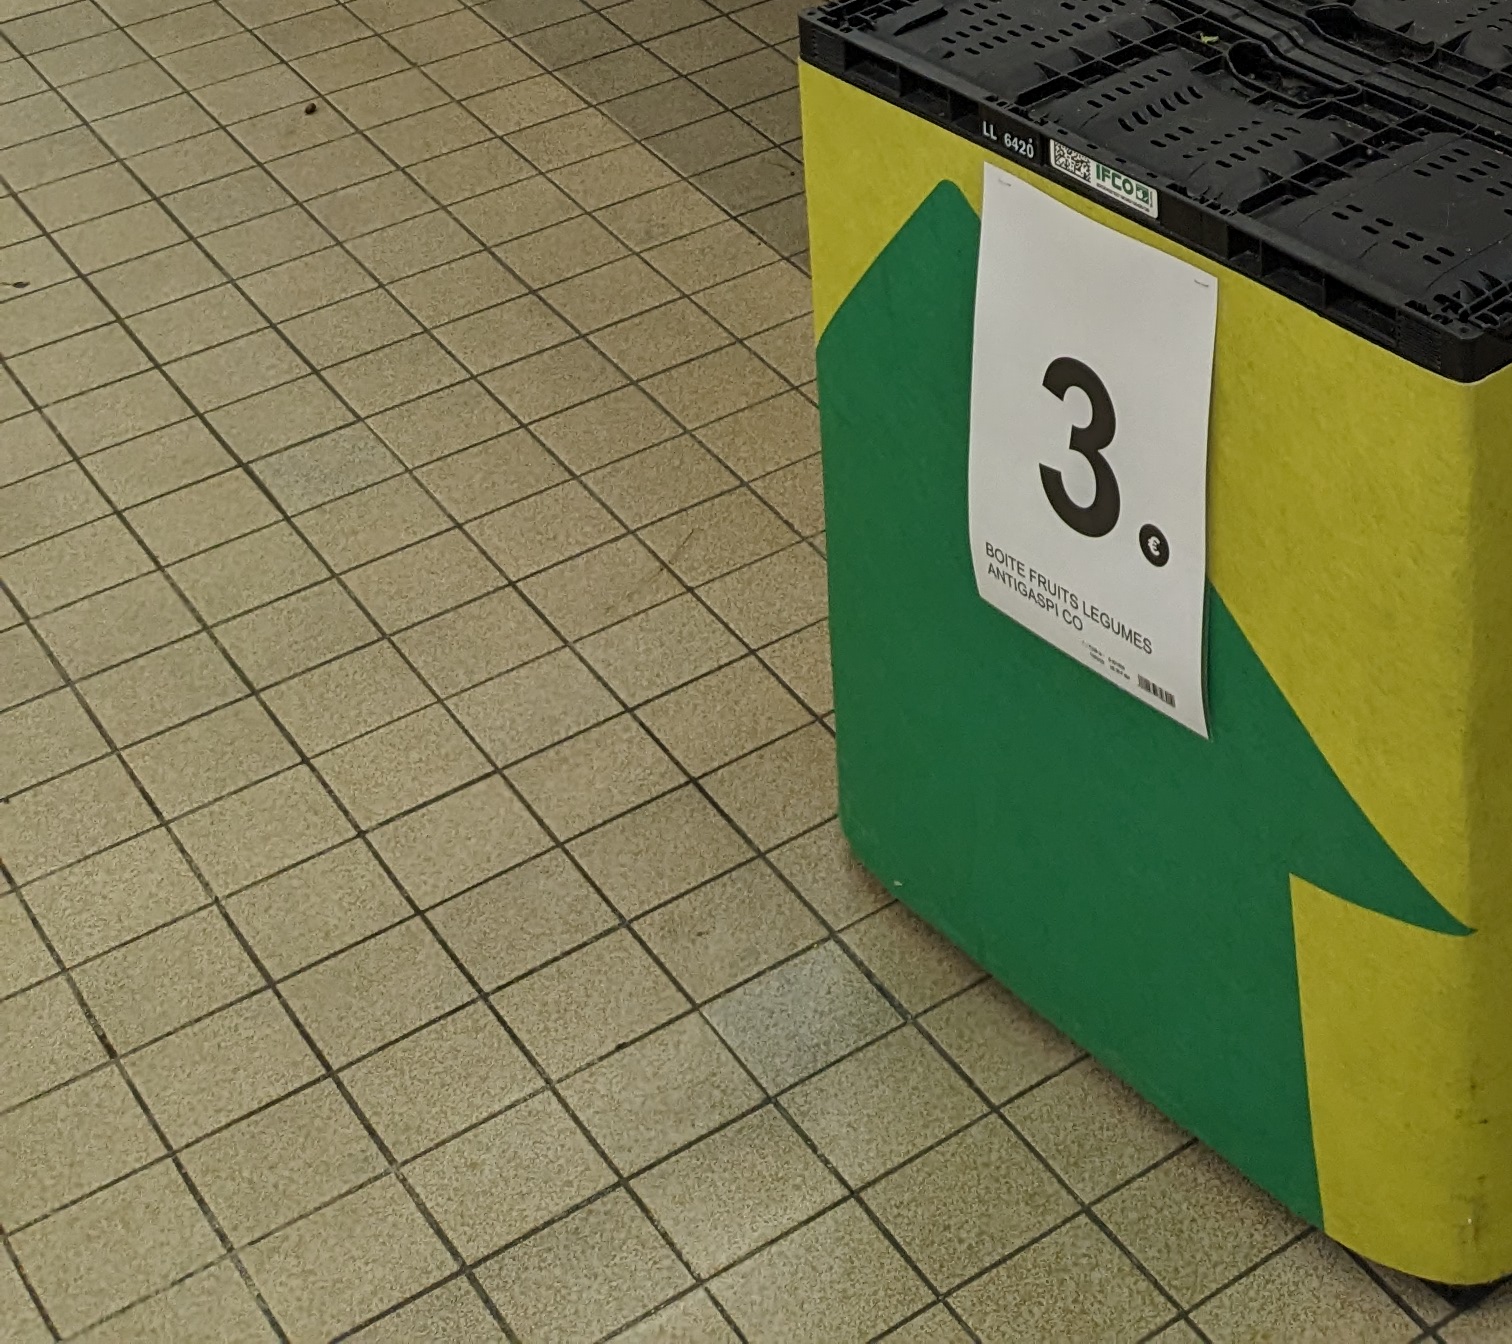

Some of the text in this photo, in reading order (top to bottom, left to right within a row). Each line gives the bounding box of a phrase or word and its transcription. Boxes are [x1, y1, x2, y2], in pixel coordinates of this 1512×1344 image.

[982, 120, 1035, 159] LL 6420
[1095, 162, 1134, 196] IFCO
[1038, 356, 1121, 538] 3
[985, 541, 1153, 655] BOITE FRUITS LEGUMES
[987, 562, 1084, 632] ANTIGASPI CO
